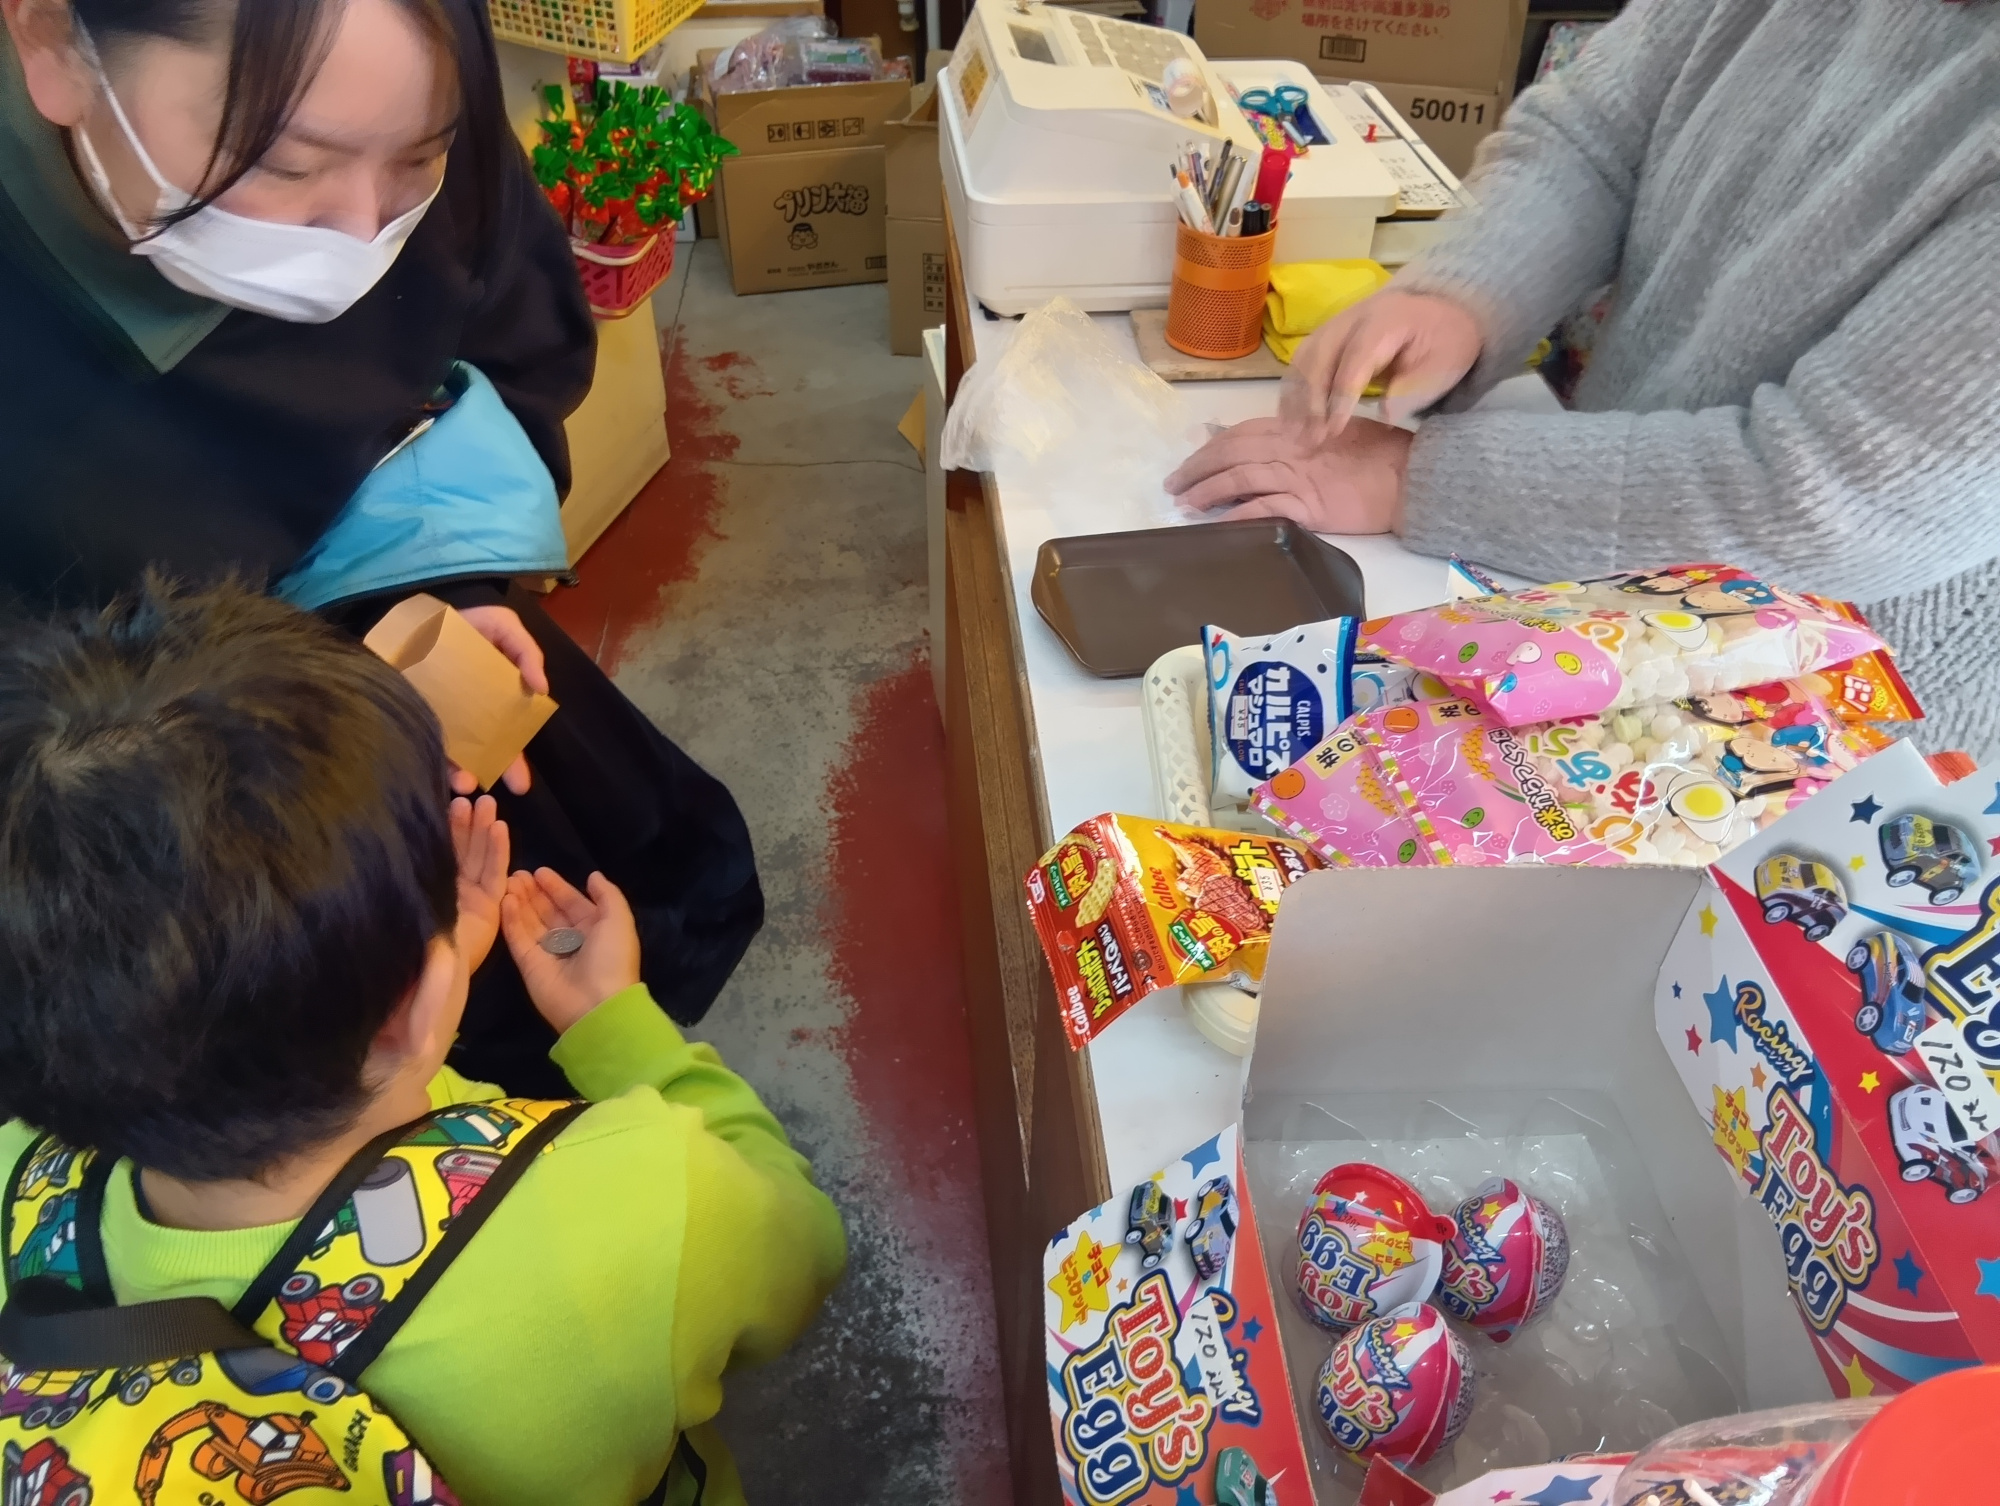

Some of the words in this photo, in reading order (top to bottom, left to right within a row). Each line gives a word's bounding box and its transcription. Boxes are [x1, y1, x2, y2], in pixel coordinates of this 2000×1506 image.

[1409, 97, 1486, 125] 50011
[773, 182, 869, 223] プリン大福
[1247, 674, 1265, 767] マシュマロ
[1265, 666, 1292, 778] カルピス
[1296, 699, 1311, 738] CALPIS
[1488, 726, 1575, 842] お米からつくった
[1149, 866, 1178, 910] Calbee
[1066, 984, 1091, 1036] Calbee
[1735, 986, 1814, 1082] Racing
[1724, 1092, 1749, 1130] チョコ
[1765, 1093, 1871, 1276] Toy's
[1087, 1240, 1112, 1289] チョコ
[1300, 1217, 1373, 1298] Egg
[1761, 1163, 1842, 1322] Egg
[1061, 1253, 1089, 1325] ビスケット
[1115, 1281, 1205, 1472] Toy's
[1070, 1340, 1146, 1502] Egg
